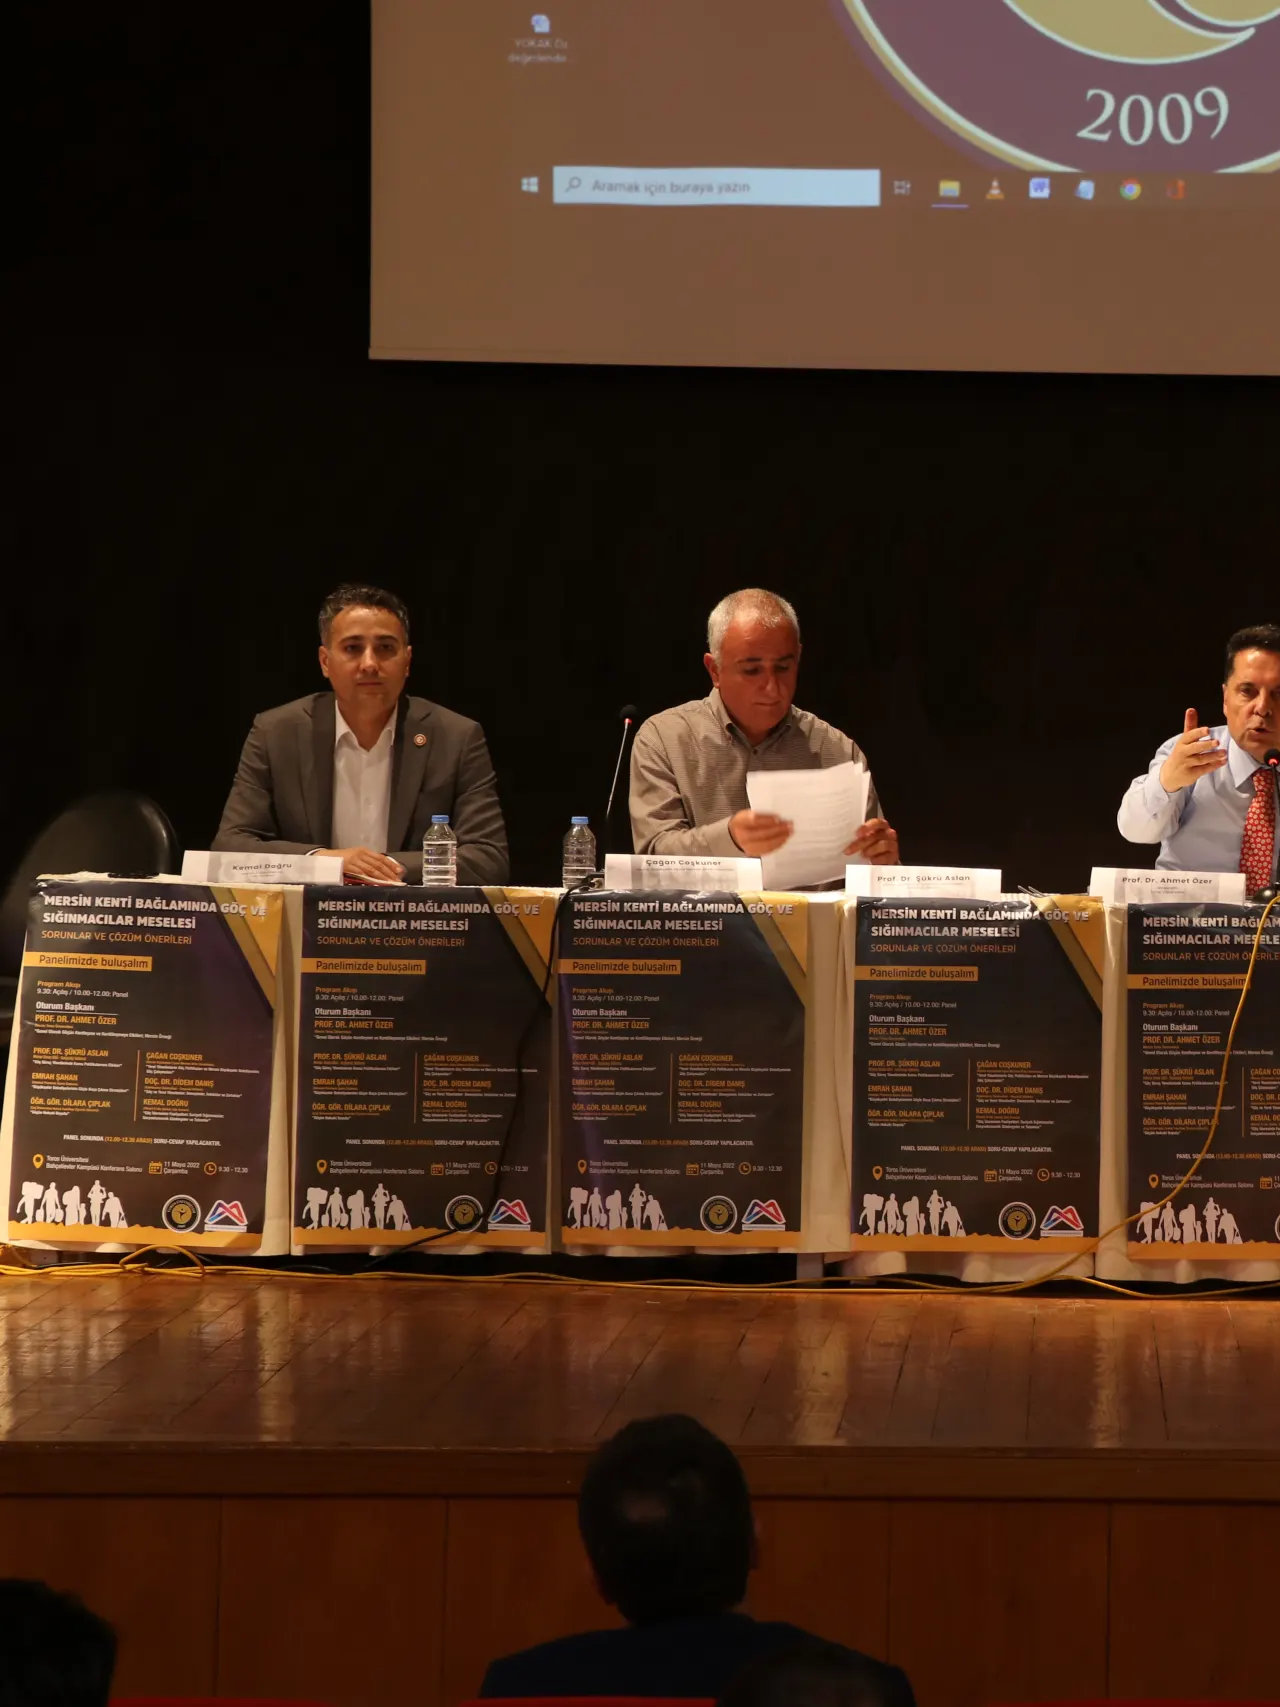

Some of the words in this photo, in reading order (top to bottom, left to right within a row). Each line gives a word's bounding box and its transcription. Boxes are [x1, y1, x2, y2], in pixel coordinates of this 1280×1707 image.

[1076, 85, 1229, 145] 2009
[592, 181, 640, 194] Aramak
[645, 181, 667, 197] için
[670, 181, 714, 195] buraya
[717, 182, 750, 195] yazın
[44, 894, 92, 907] MERSİN
[95, 896, 132, 909] KENTİ
[135, 897, 217, 913] BAĞLAMINDA
[220, 902, 246, 917] GÖÇ
[251, 905, 266, 916] VE
[318, 899, 365, 912] MERSİN
[369, 900, 405, 913] KENTİ
[409, 900, 490, 914] BAĞLAMINDA
[494, 903, 519, 916] GÖÇ
[524, 904, 540, 915] VE
[574, 900, 620, 912] MERSİN
[623, 900, 659, 913] KENTİ
[663, 898, 744, 914] BAĞLAMINDA
[748, 901, 773, 916] GÖÇ
[777, 904, 792, 914] VE
[43, 910, 133, 926] SIĞINMACILAR
[137, 916, 196, 929] MESELESİ
[872, 907, 918, 919] MERSİN
[921, 907, 956, 920] KENTİ
[960, 907, 1041, 921] BAĞLAMINDA
[1044, 910, 1069, 923] GÖÇ
[1074, 911, 1089, 921] VE
[318, 916, 407, 930] SIĞINMACILAR
[411, 918, 468, 931] MESELESİ
[573, 916, 661, 930] SIĞINMACILAR
[665, 918, 723, 931] MESELESİ
[1143, 915, 1189, 928] MERSİN
[1192, 915, 1228, 928] KENTİ
[871, 924, 958, 937] SIĞINMACILAR
[962, 925, 1020, 937] MESELESİ
[42, 931, 91, 940] SORUNLAR
[94, 933, 106, 941] VE
[109, 932, 142, 943] ÇÖZÜM
[146, 934, 192, 944] ÖNERİLERİ
[317, 937, 366, 945] SORUNLAR
[370, 937, 381, 945] VE
[383, 937, 416, 947] ÇÖZÜM
[419, 937, 465, 947] ÖNERİLERİ
[1143, 931, 1230, 944] SIĞINMACILAR
[871, 944, 919, 952] SORUNLAR
[922, 944, 933, 952] VE
[936, 943, 967, 954] ÇÖZÜM
[970, 943, 1016, 953] ÖNERİLERİ
[39, 955, 98, 966] Panelimizde
[101, 958, 148, 969] buluşalım
[316, 961, 374, 971] Panelimizde
[377, 962, 422, 973] buluşalım
[573, 961, 629, 971] Panelimizde
[632, 962, 677, 973] buluşalım
[870, 968, 927, 978] Panelimizde
[929, 969, 974, 980] buluşalım
[1143, 976, 1199, 986] Panelimizde
[1202, 978, 1246, 988] buluşalım
[36, 1001, 63, 1010] Oturum
[65, 1003, 94, 1012] Başkanı
[315, 1007, 341, 1015] Oturum
[343, 1008, 371, 1017] Başkanı
[56, 1015, 69, 1023] DR.
[71, 1016, 96, 1024] AHMET
[98, 1015, 117, 1025] ÖZER
[315, 1020, 334, 1028] PROF.
[375, 1020, 393, 1029] ÖZER
[869, 1015, 895, 1023] Oturum
[897, 1015, 925, 1024] Başkanı
[1143, 1023, 1168, 1031] Oturum
[1170, 1023, 1198, 1033] Başkanı
[32, 1072, 54, 1080] EMRAH
[55, 1073, 78, 1082] ŞAHAN
[161, 1078, 172, 1086] DR.
[143, 1099, 165, 1107] KEMAL
[167, 1098, 188, 1107] DOĞRU
